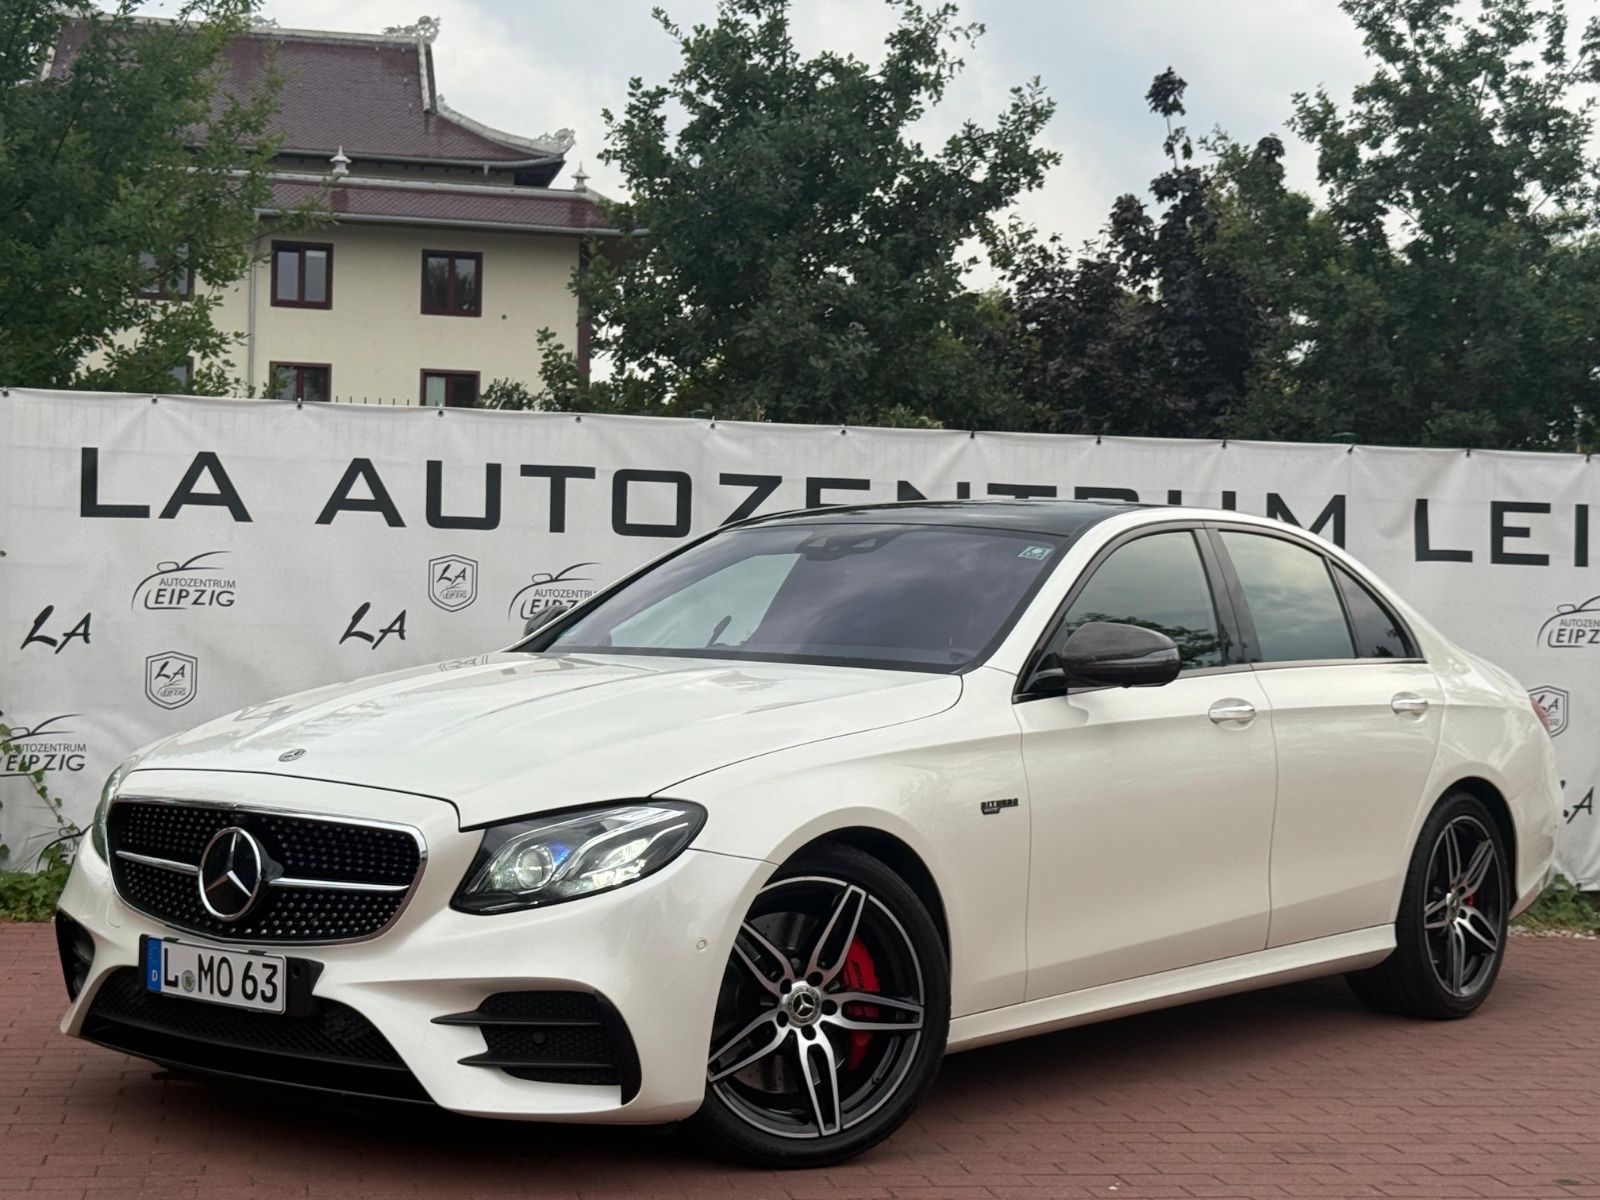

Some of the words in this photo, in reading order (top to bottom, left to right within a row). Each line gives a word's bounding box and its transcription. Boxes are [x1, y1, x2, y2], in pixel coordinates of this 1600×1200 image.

[80, 447, 253, 522] LA
[1414, 498, 1589, 567] LEI
[159, 577, 236, 588] AUTOZENTRUM
[437, 563, 467, 585] LA
[20, 604, 92, 655] LA
[338, 601, 407, 651] LA
[154, 660, 186, 682] LA
[164, 947, 179, 988] L
[198, 953, 234, 998] MO
[241, 960, 278, 1003] 63
